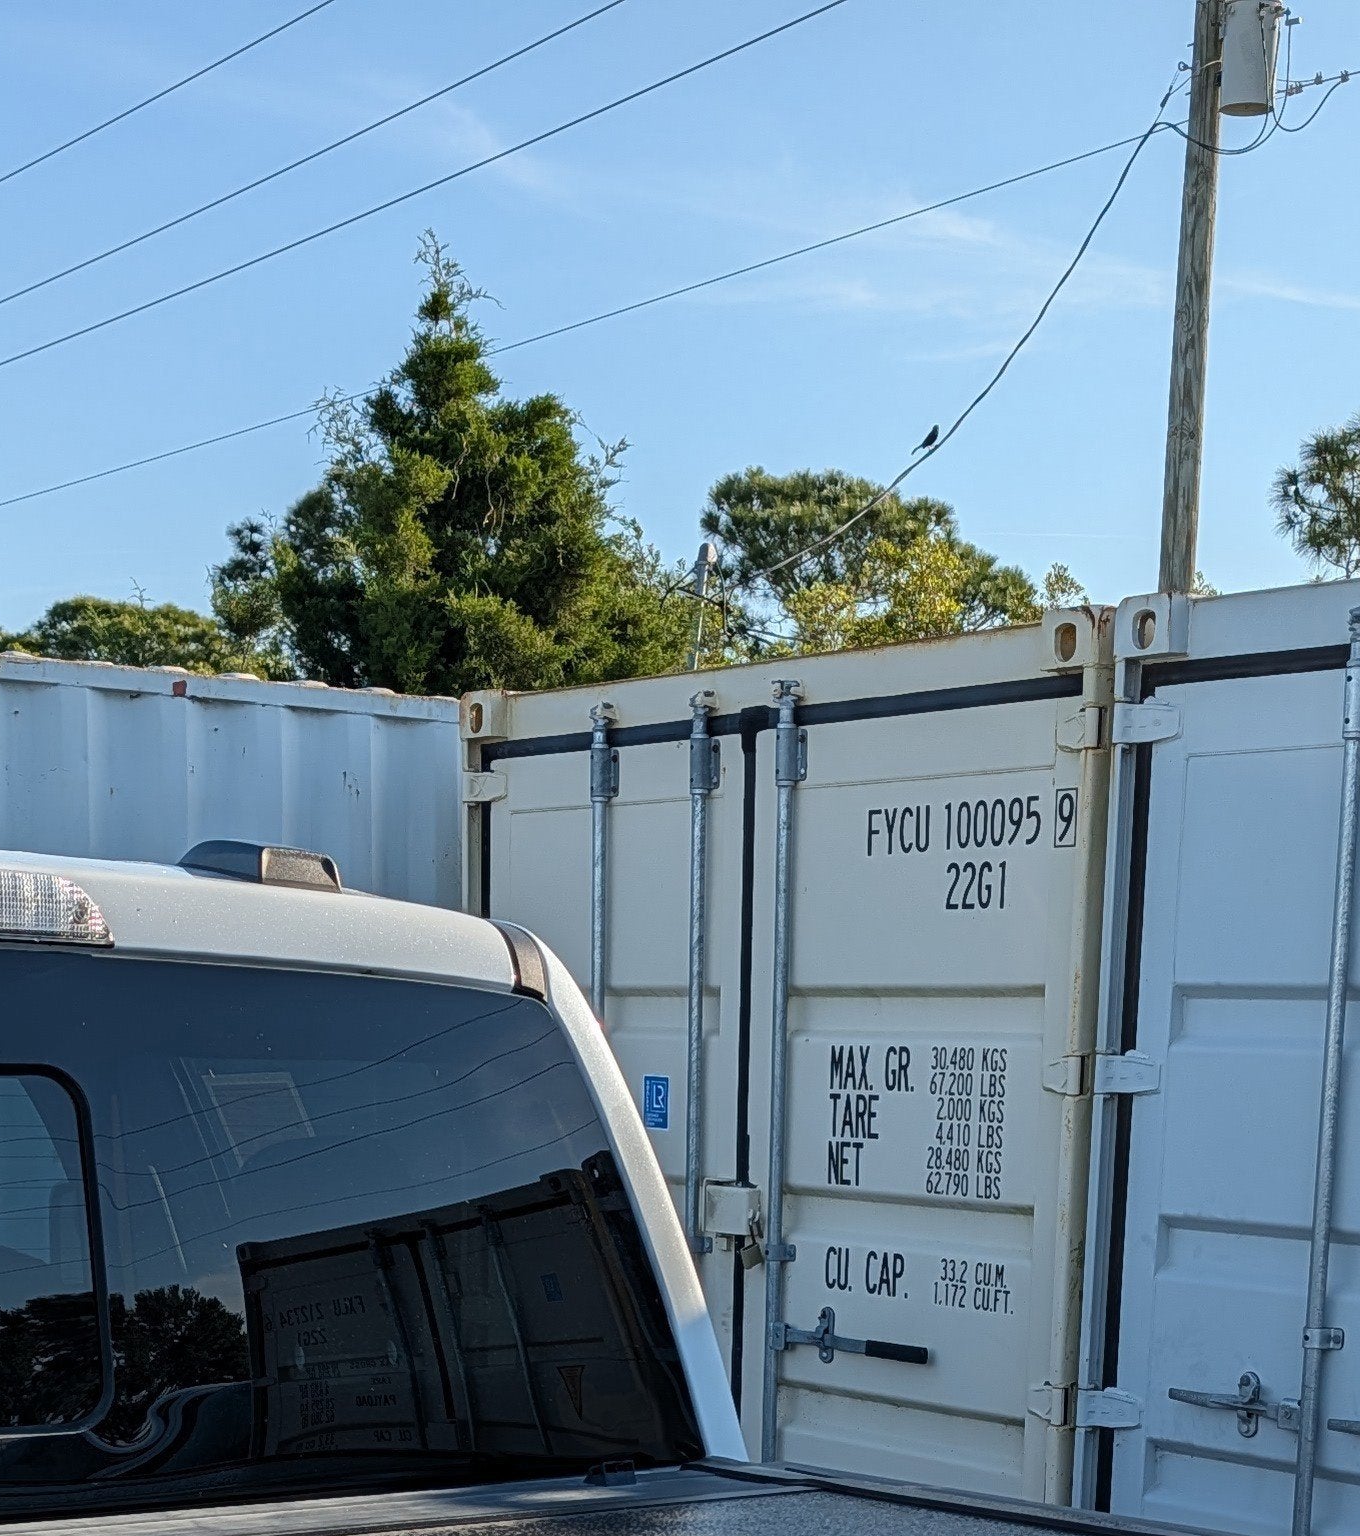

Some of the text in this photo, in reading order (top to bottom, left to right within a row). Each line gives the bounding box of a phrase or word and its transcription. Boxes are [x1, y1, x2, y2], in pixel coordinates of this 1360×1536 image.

[868, 793, 1074, 856] FYCU 100095 9
[946, 861, 1006, 909] 22G1
[830, 1045, 1007, 1092] MAX. GR. 30,480 KGS
[930, 1072, 1005, 1098] 67,200 LBS
[653, 1085, 664, 1108] LR
[830, 1093, 1004, 1139] TARE 2,000 KGS
[936, 1122, 1003, 1149] 4,410 LBS
[828, 1141, 1002, 1186] NET 28,480 KGS
[926, 1172, 1000, 1200] 62,790 LBS
[826, 1247, 1006, 1298] CU. CAP. 33.2 CU.M.
[934, 1282, 1013, 1314] 1,172 CU.FT.
